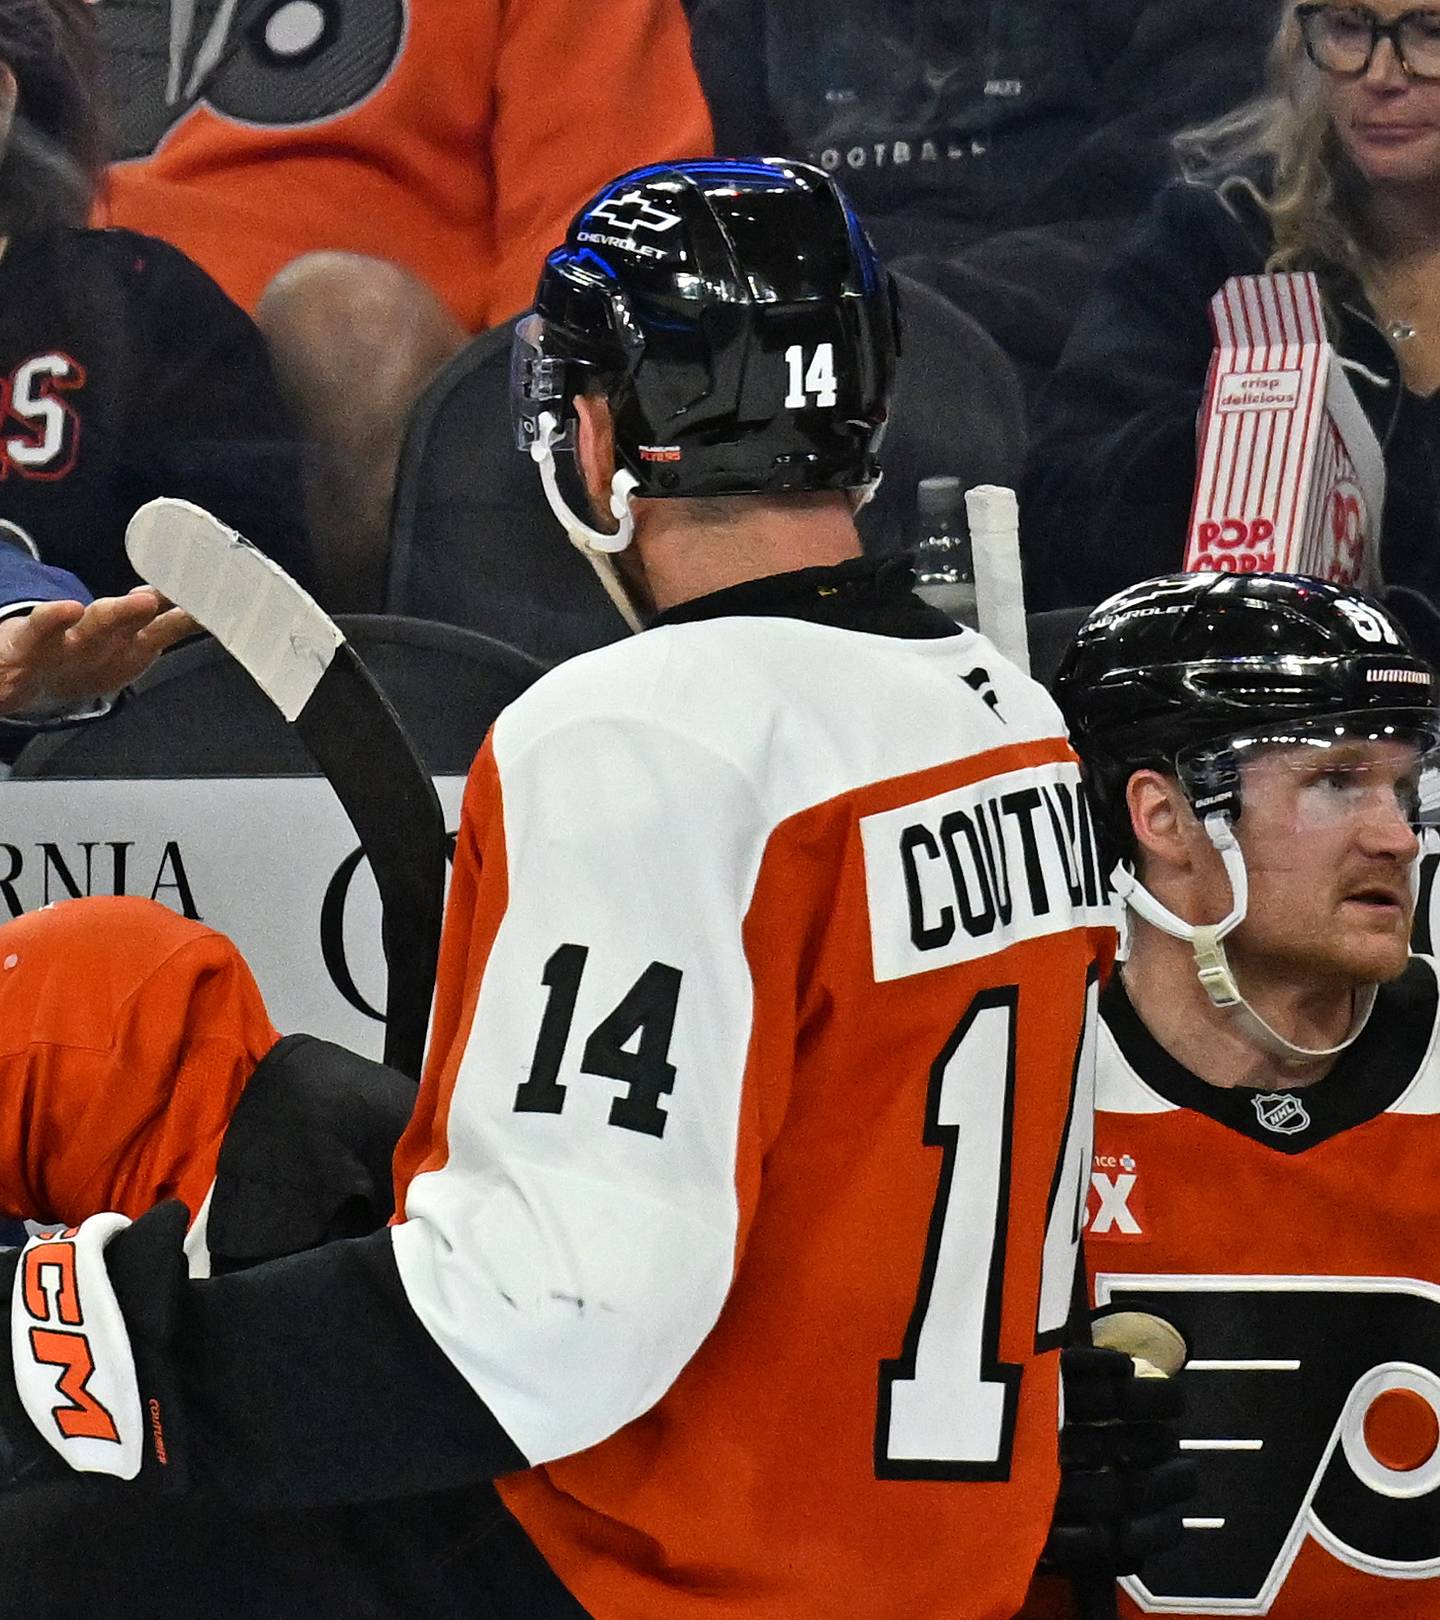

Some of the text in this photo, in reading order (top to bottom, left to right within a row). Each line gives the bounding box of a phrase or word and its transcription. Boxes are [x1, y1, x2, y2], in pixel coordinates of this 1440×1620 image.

[811, 141, 986, 170] OOTBALL
[577, 231, 668, 260] CHEVROLET
[784, 343, 838, 408] 14
[1241, 377, 1280, 391] crisp
[1221, 393, 1294, 405] delicious
[1198, 518, 1275, 552] POP
[513, 943, 683, 1139] 14
[1269, 1104, 1296, 1125] NHL
[22, 1227, 122, 1445] CM
